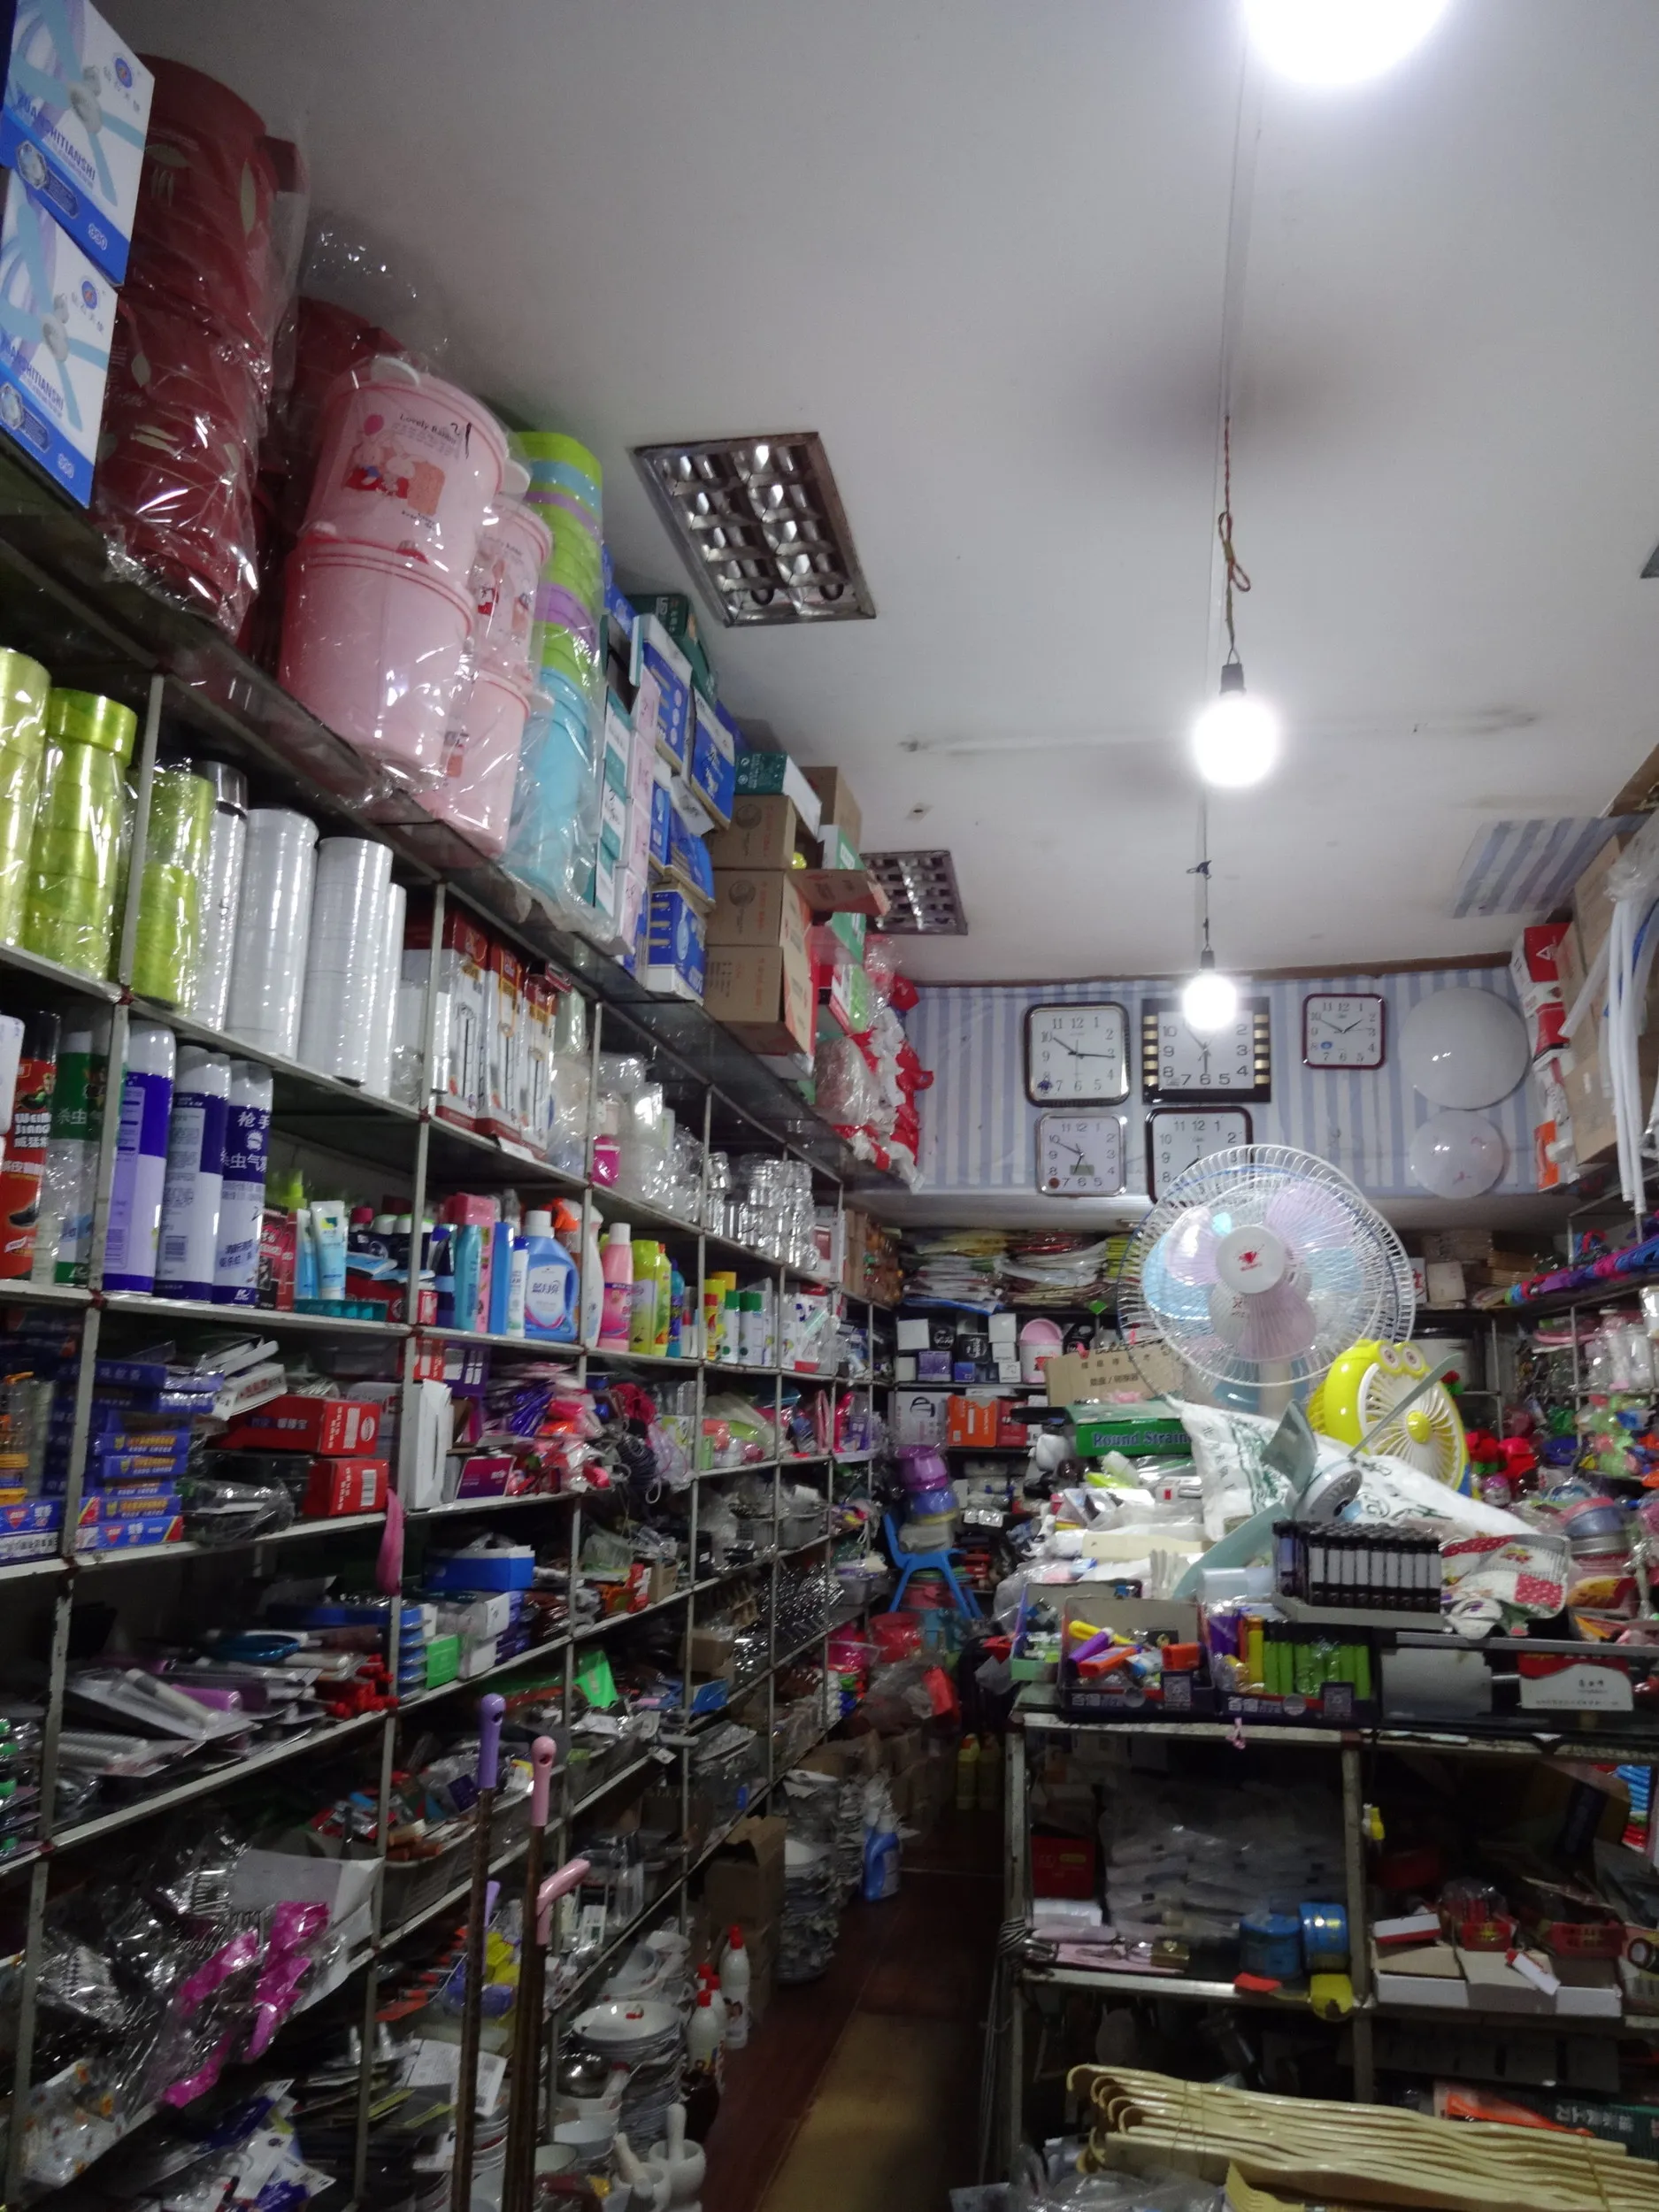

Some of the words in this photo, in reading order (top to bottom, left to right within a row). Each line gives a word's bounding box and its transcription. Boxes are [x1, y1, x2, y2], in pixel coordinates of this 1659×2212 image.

[1324, 1002, 1332, 1011] 11
[1338, 1002, 1349, 1011] 12
[1053, 1018, 1062, 1029] 11
[1071, 1017, 1084, 1028] 12
[1094, 1017, 1099, 1028] 1
[1041, 1031, 1052, 1042] 10
[1105, 1028, 1114, 1040] 2
[1163, 1025, 1178, 1037] 10
[1236, 1024, 1248, 1035] 2
[1163, 1045, 1174, 1056] 9
[1237, 1044, 1248, 1056] 3
[1367, 1042, 1374, 1052] 4
[1042, 1051, 1050, 1063] 9
[1324, 1052, 1329, 1061] 7
[1340, 1052, 1347, 1061] 6
[1107, 1069, 1114, 1079] 4
[1163, 1066, 1174, 1078] 8
[1237, 1065, 1248, 1076] 4
[1181, 1074, 1191, 1086] 7
[1200, 1073, 1211, 1085] 6
[1218, 1073, 1231, 1085] 5
[1056, 1079, 1063, 1092] 7
[1074, 1080, 1082, 1091] 6
[1094, 1079, 1102, 1091] 5
[1062, 1123, 1071, 1132] 11
[1076, 1123, 1087, 1132] 12
[1174, 1120, 1185, 1131] 11
[1192, 1120, 1205, 1131] 12
[1214, 1120, 1220, 1131] 1
[1049, 1134, 1060, 1144] 10
[1106, 1133, 1115, 1142] 2
[1160, 1134, 1171, 1144] 10
[1227, 1133, 1237, 1143] 2
[1048, 1150, 1057, 1160] 9
[1106, 1150, 1115, 1159] 3
[1162, 1152, 1171, 1164] 9
[1048, 1166, 1057, 1176] 8
[1062, 1178, 1071, 1187] 7
[1078, 1177, 1087, 1187] 6
[1094, 1177, 1102, 1187] 5
[1162, 1171, 1171, 1183] 8
[1092, 1431, 1139, 1448] Round
